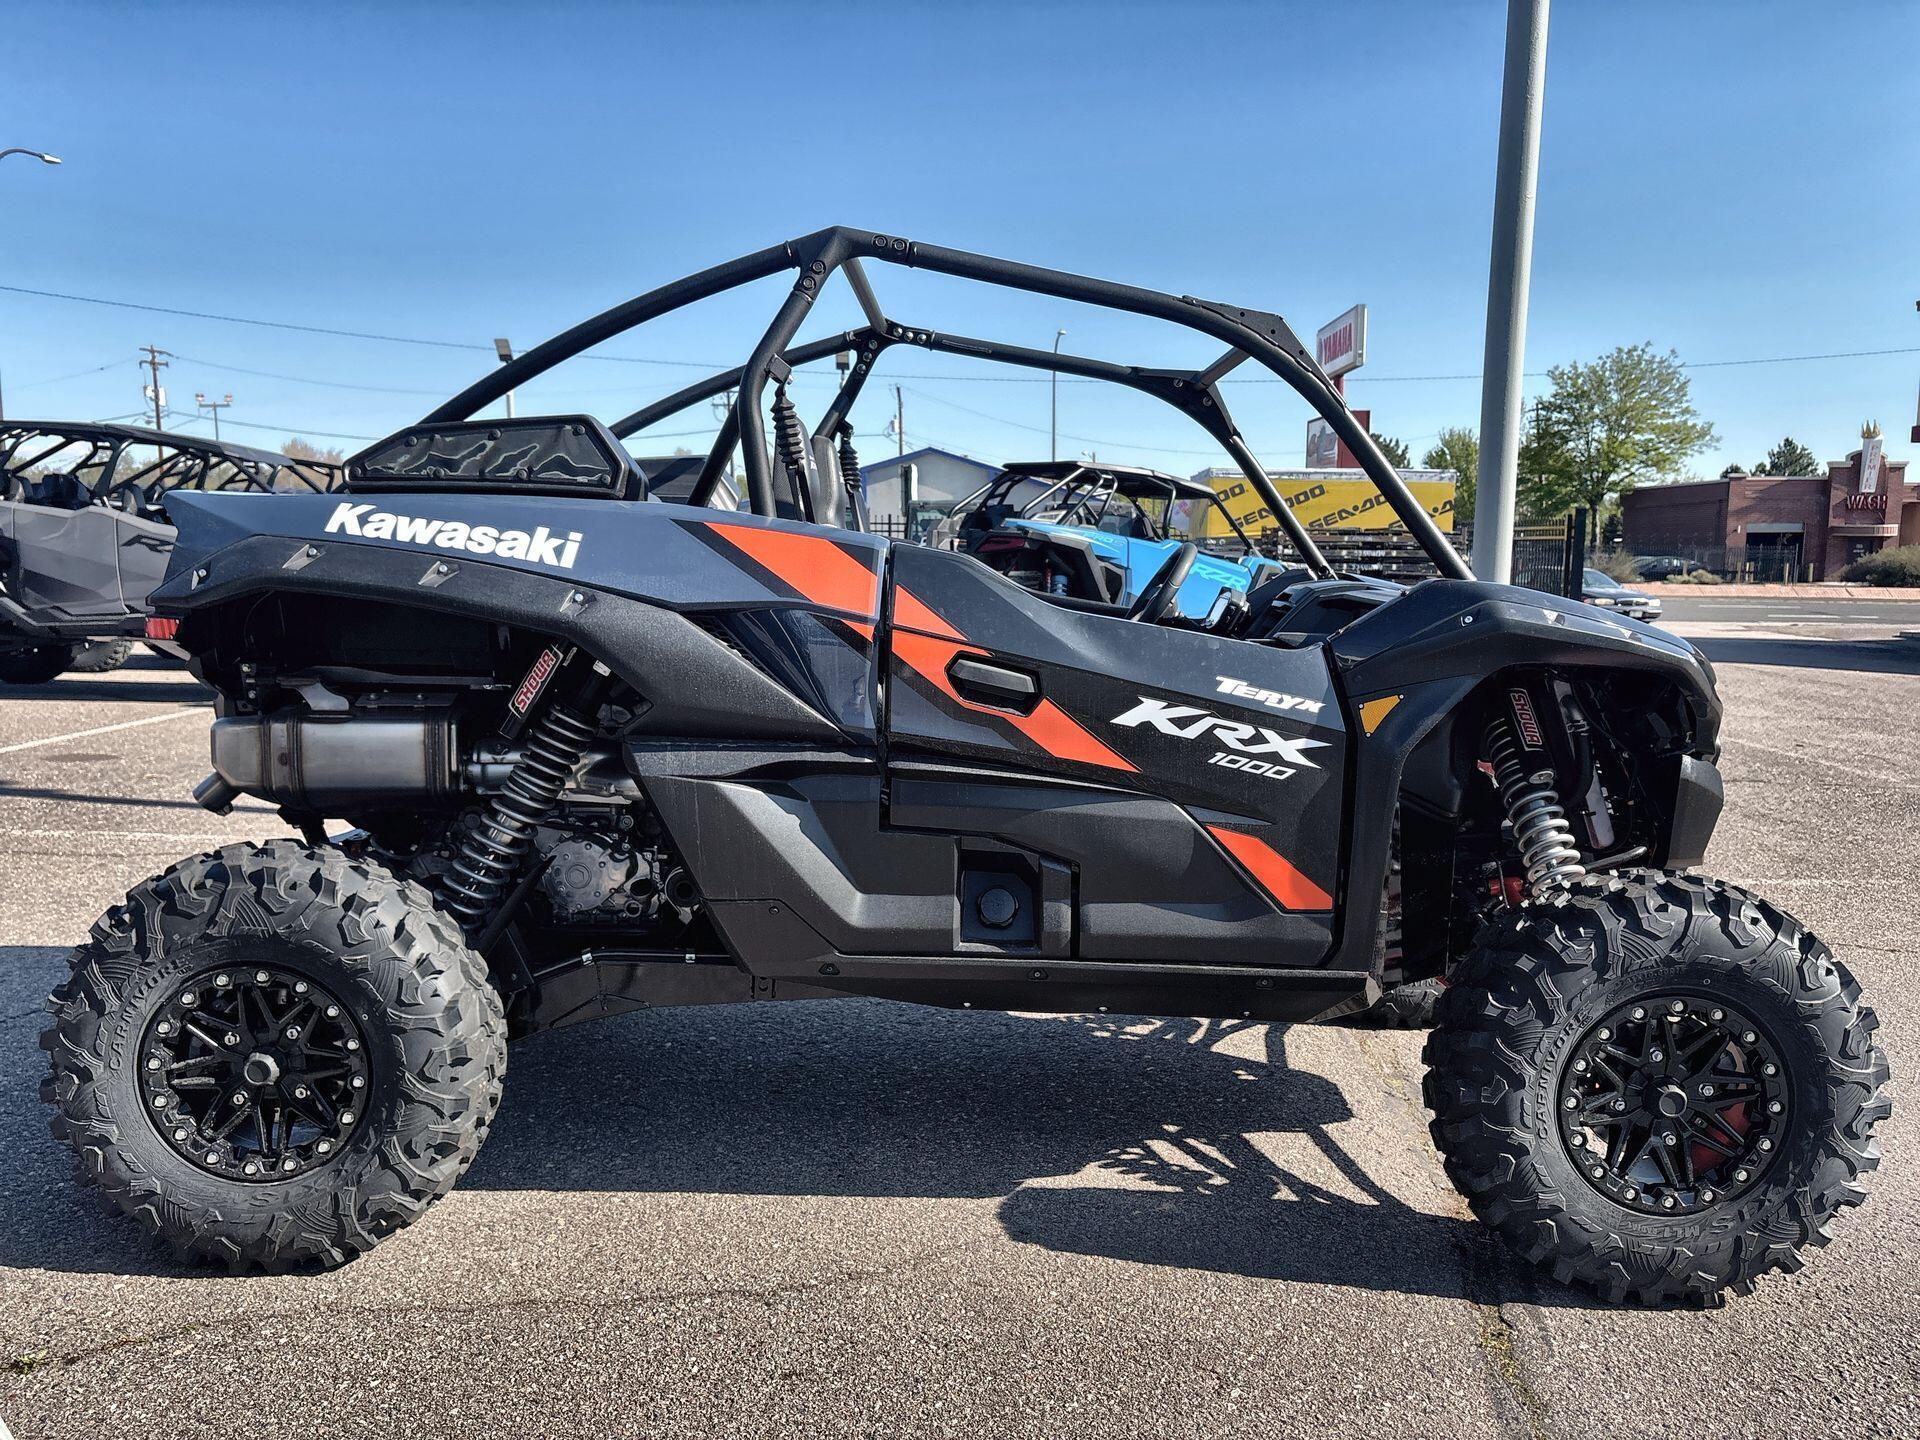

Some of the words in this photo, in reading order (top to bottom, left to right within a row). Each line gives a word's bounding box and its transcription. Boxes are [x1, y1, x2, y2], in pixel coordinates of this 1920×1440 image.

[1324, 323, 1353, 365] YAMAHA
[1846, 494, 1888, 510] WASH
[324, 502, 584, 570] Kawasaki
[1189, 563, 1246, 593] RZR
[514, 649, 557, 714] SHOWA
[1216, 676, 1327, 714] TERYX
[1109, 696, 1332, 770] KRX
[1510, 692, 1543, 745] SHOWA
[1207, 752, 1297, 780] 1000
